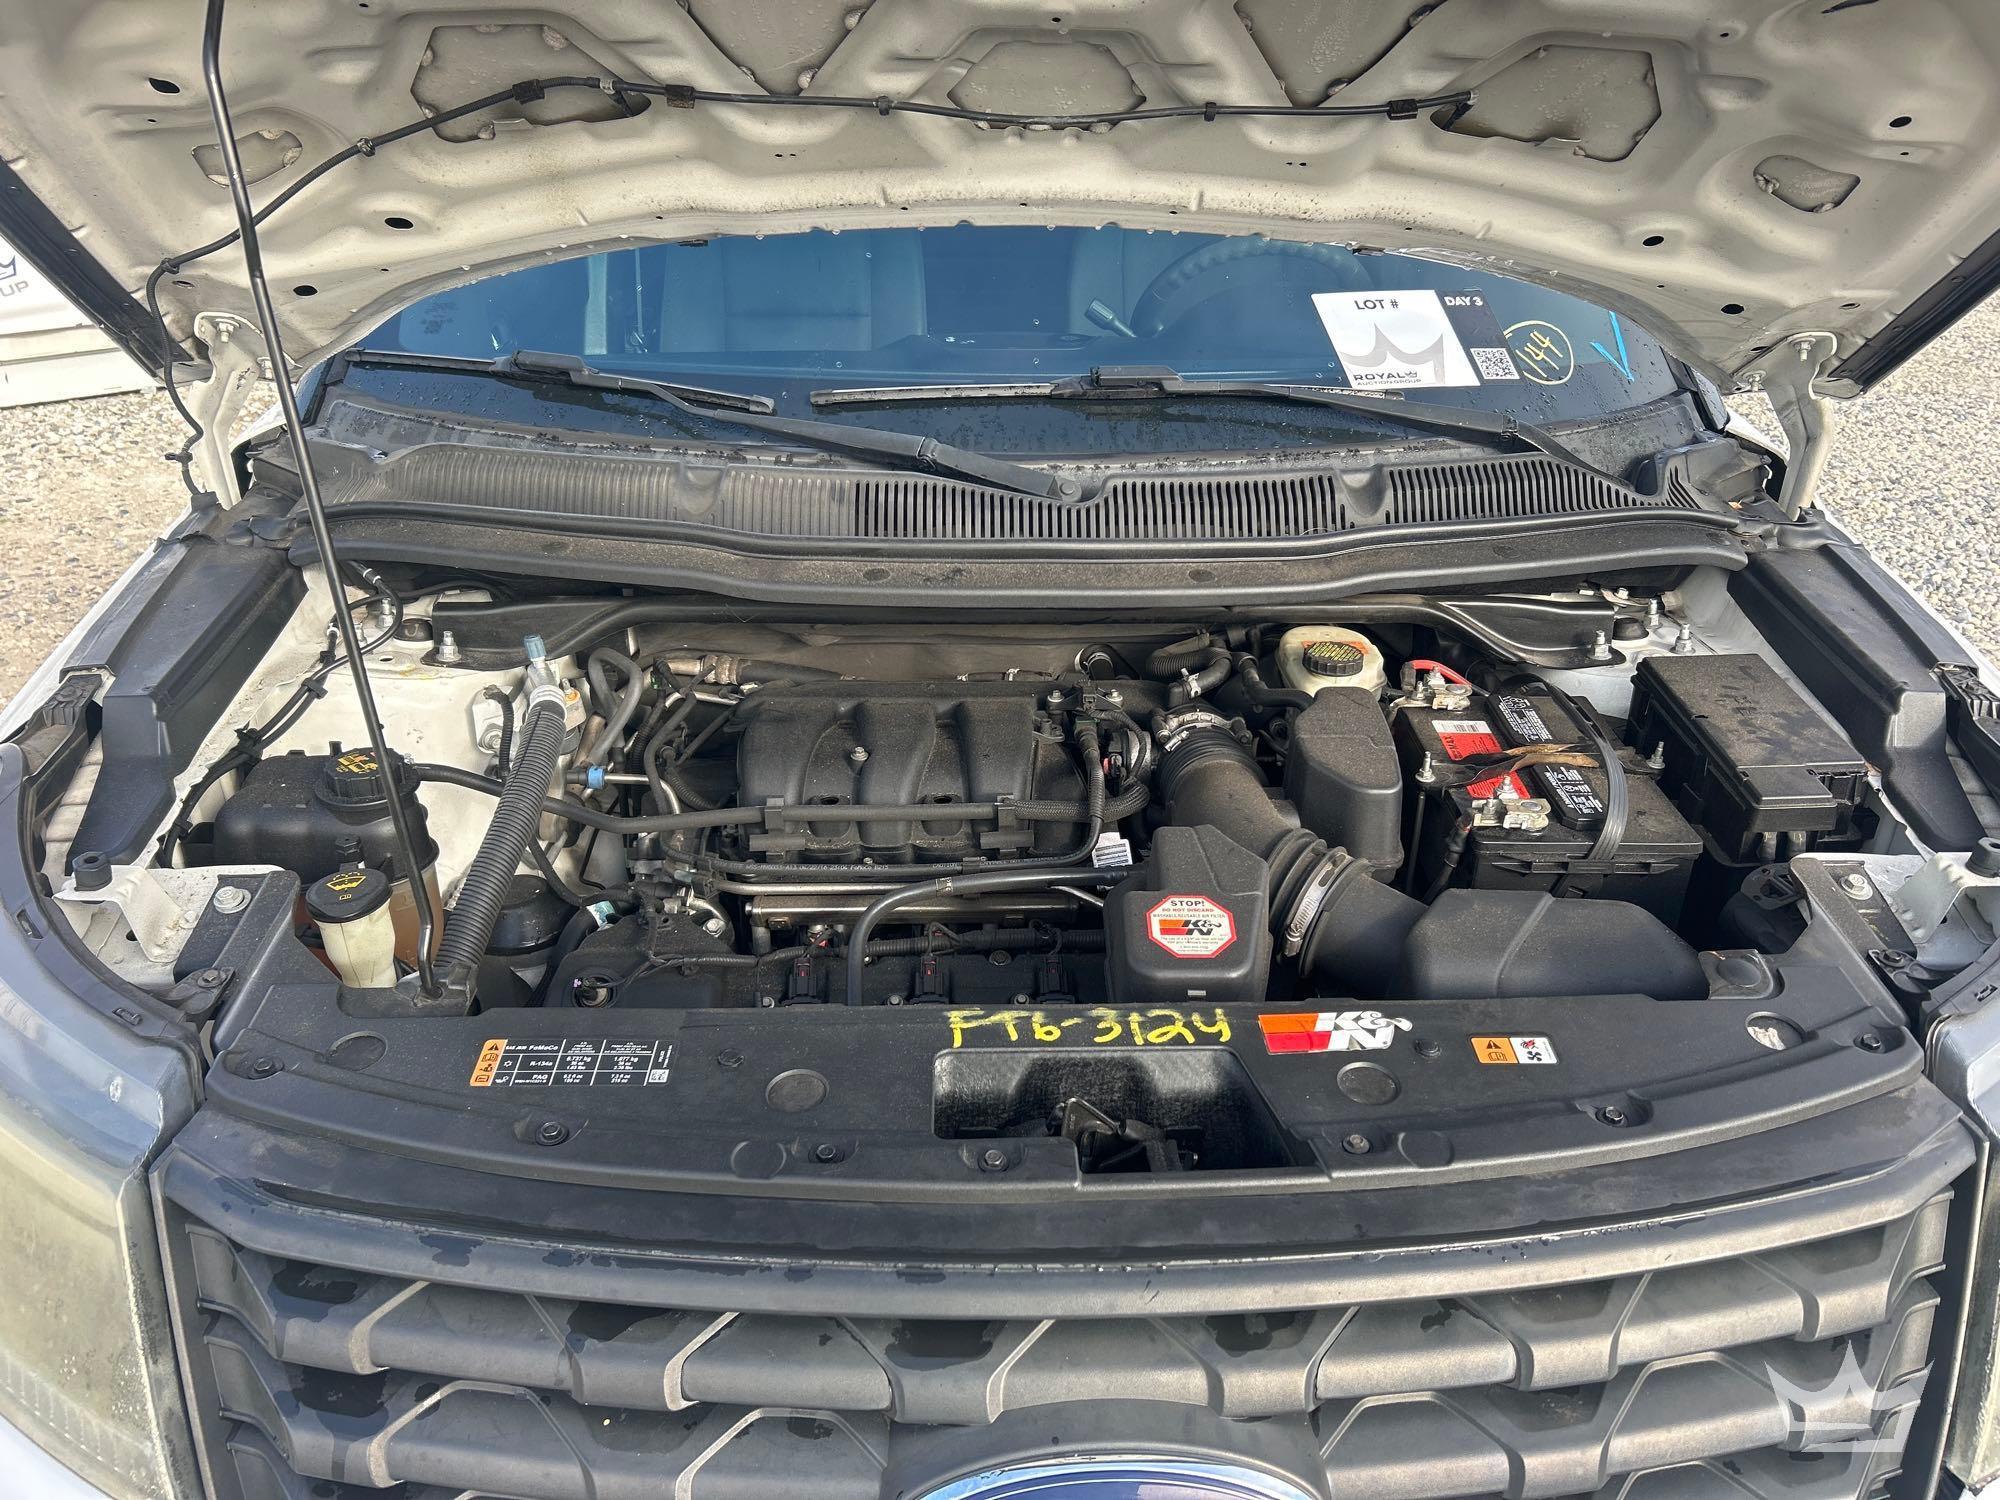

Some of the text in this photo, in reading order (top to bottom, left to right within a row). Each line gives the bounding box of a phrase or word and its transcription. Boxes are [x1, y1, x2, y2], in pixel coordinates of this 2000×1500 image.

[1354, 299, 1400, 310] LOT #
[1443, 296, 1484, 306] DAY 3
[1515, 329, 1564, 378] 144
[1353, 372, 1406, 381] ROYAL
[1181, 919, 1222, 936] K&N
[1313, 1011, 1413, 1052] K&N
